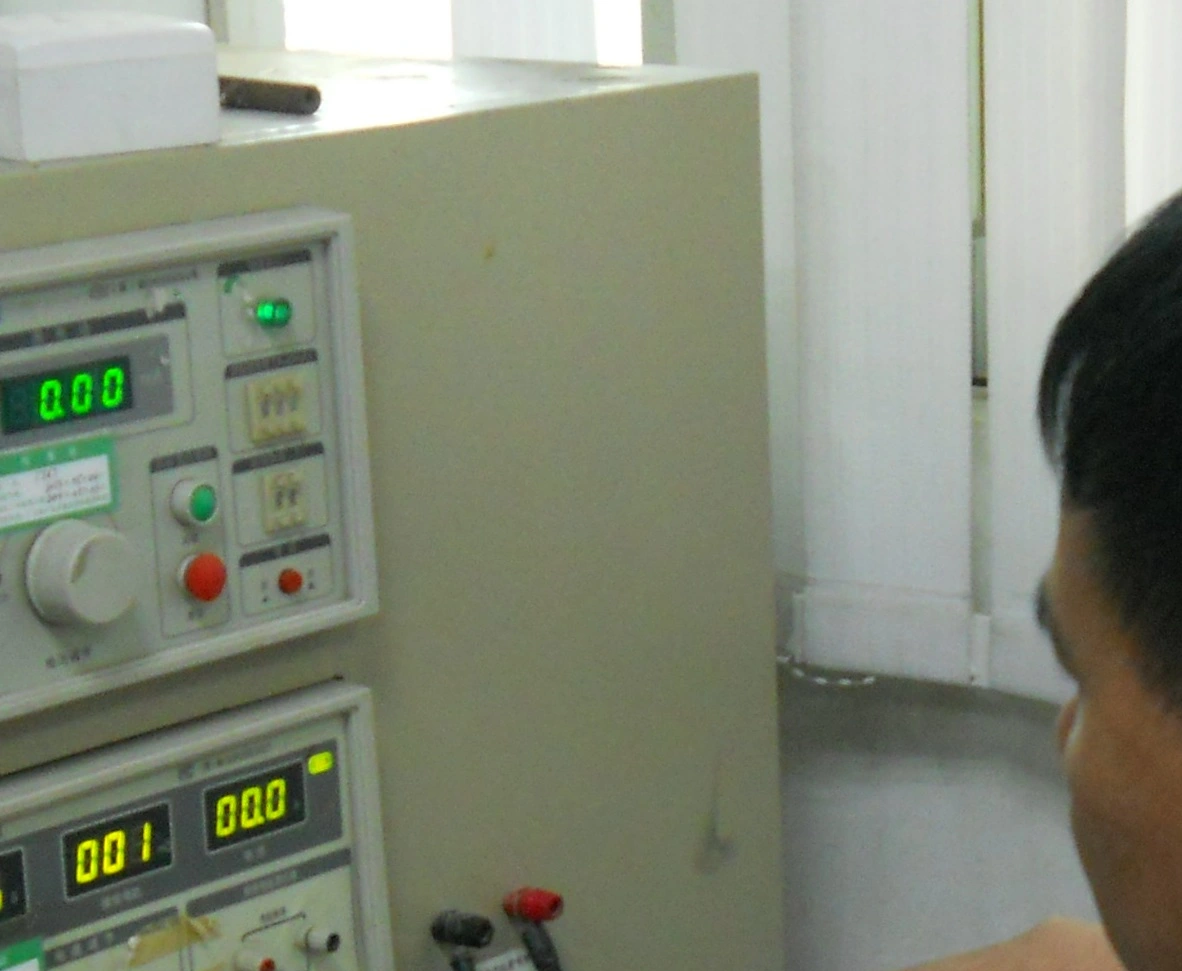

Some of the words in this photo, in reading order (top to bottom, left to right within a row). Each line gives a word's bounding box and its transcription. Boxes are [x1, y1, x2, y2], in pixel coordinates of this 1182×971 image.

[38, 366, 125, 421] 0.00
[215, 778, 287, 838] 00.0
[75, 821, 152, 885] 001
